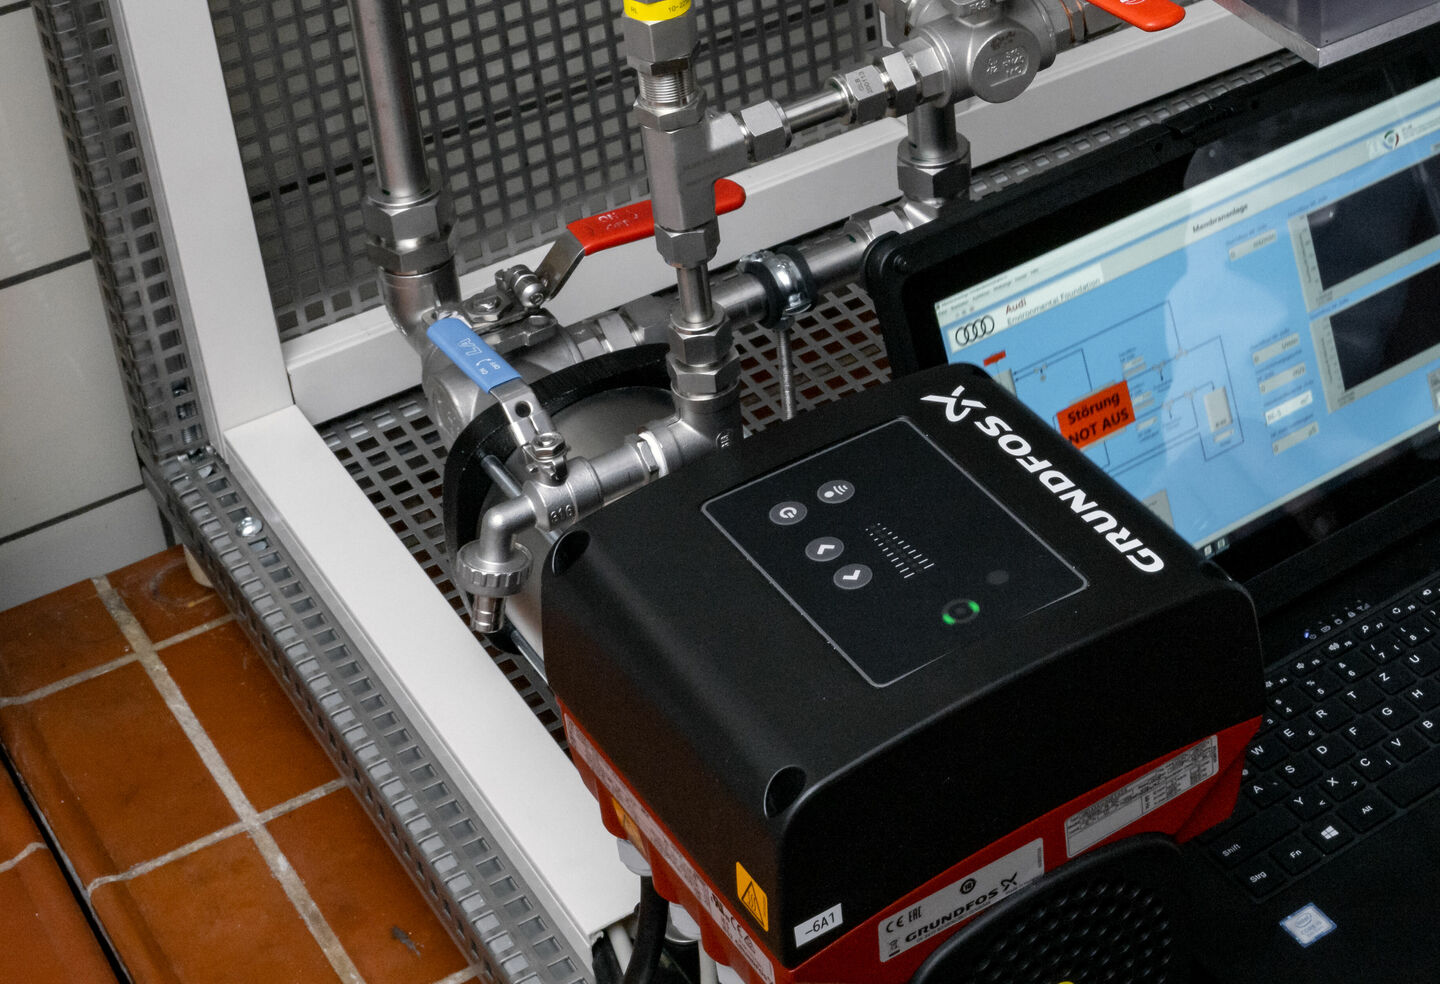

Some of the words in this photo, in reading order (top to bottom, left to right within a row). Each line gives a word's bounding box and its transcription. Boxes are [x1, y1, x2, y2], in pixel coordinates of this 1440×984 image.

[1005, 298, 1027, 314] Audi
[1007, 300, 1059, 325] Environmental
[1060, 279, 1101, 301] Foundation
[1067, 391, 1121, 426] Störung
[1068, 424, 1101, 445] NOT
[1102, 408, 1130, 432] AUS
[974, 416, 1165, 573] GRUNDFOS
[1409, 654, 1420, 664] U
[1379, 672, 1390, 682] Z
[1347, 690, 1357, 700] T
[1412, 689, 1423, 698] H
[1315, 709, 1328, 718] R
[1382, 707, 1393, 716] G
[1422, 720, 1433, 729] B
[1283, 728, 1295, 737] E
[1349, 726, 1358, 735] F
[1391, 738, 1401, 747] V
[1251, 745, 1264, 756] W
[1316, 745, 1327, 754] D
[1360, 758, 1370, 766] C
[1285, 765, 1295, 774] S
[1327, 777, 1339, 787] X
[1253, 785, 1263, 794] A
[1293, 796, 1304, 806] Y
[1361, 805, 1373, 814] Alt
[1222, 843, 1241, 858] Shift
[1290, 849, 1302, 858] Fn
[1250, 871, 1267, 883] Strg
[905, 888, 999, 943] GRUNDFOS
